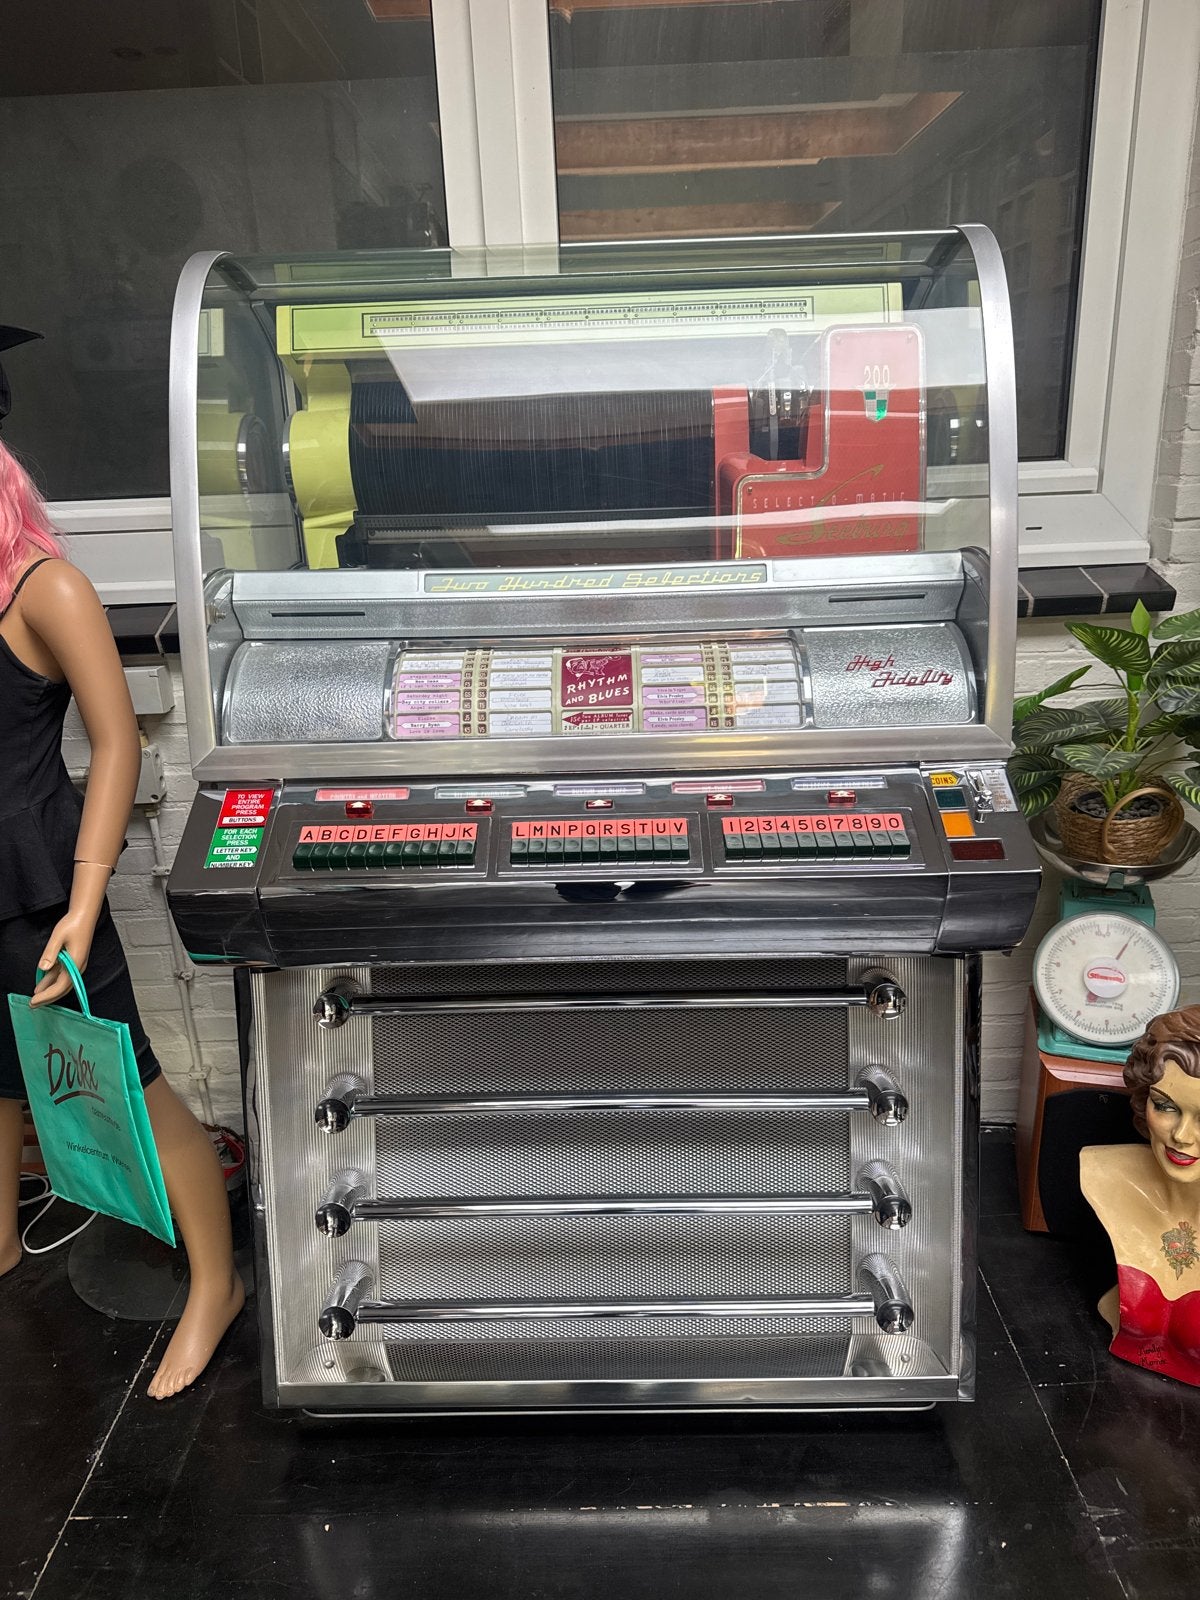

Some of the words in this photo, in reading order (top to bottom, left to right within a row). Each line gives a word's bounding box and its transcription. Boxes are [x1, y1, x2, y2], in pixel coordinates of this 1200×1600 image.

[863, 365, 890, 387] 200
[431, 577, 489, 591] Two
[498, 575, 614, 591] Hundred
[622, 569, 763, 588] Selections
[846, 653, 895, 672] High
[566, 673, 628, 694] RHYTHM
[872, 669, 954, 688] Fidelity
[565, 695, 584, 706] AND
[588, 686, 630, 704] BLUES
[931, 776, 954, 785] COINS
[303, 831, 313, 840] A
[321, 830, 332, 840] B
[339, 830, 349, 840] C
[357, 830, 367, 839] D
[375, 829, 385, 839] E
[392, 829, 402, 839] F
[410, 829, 420, 838] G
[428, 828, 438, 838] H
[446, 828, 455, 837] J
[463, 827, 472, 837] K
[516, 827, 524, 836] L
[534, 826, 543, 836] M
[551, 826, 560, 835] N
[569, 825, 578, 835] P
[586, 825, 595, 835] Q
[604, 824, 613, 834] R
[621, 824, 630, 834] S
[639, 823, 647, 833] T
[656, 823, 666, 833] U
[674, 823, 682, 833] V
[745, 821, 754, 831] 2
[763, 821, 772, 831] 3
[781, 821, 790, 830] 4
[798, 820, 808, 830] 5
[816, 820, 826, 830] 6
[834, 819, 843, 829] 7
[852, 819, 863, 829] 8
[871, 818, 881, 828] 9
[889, 818, 899, 828] 0
